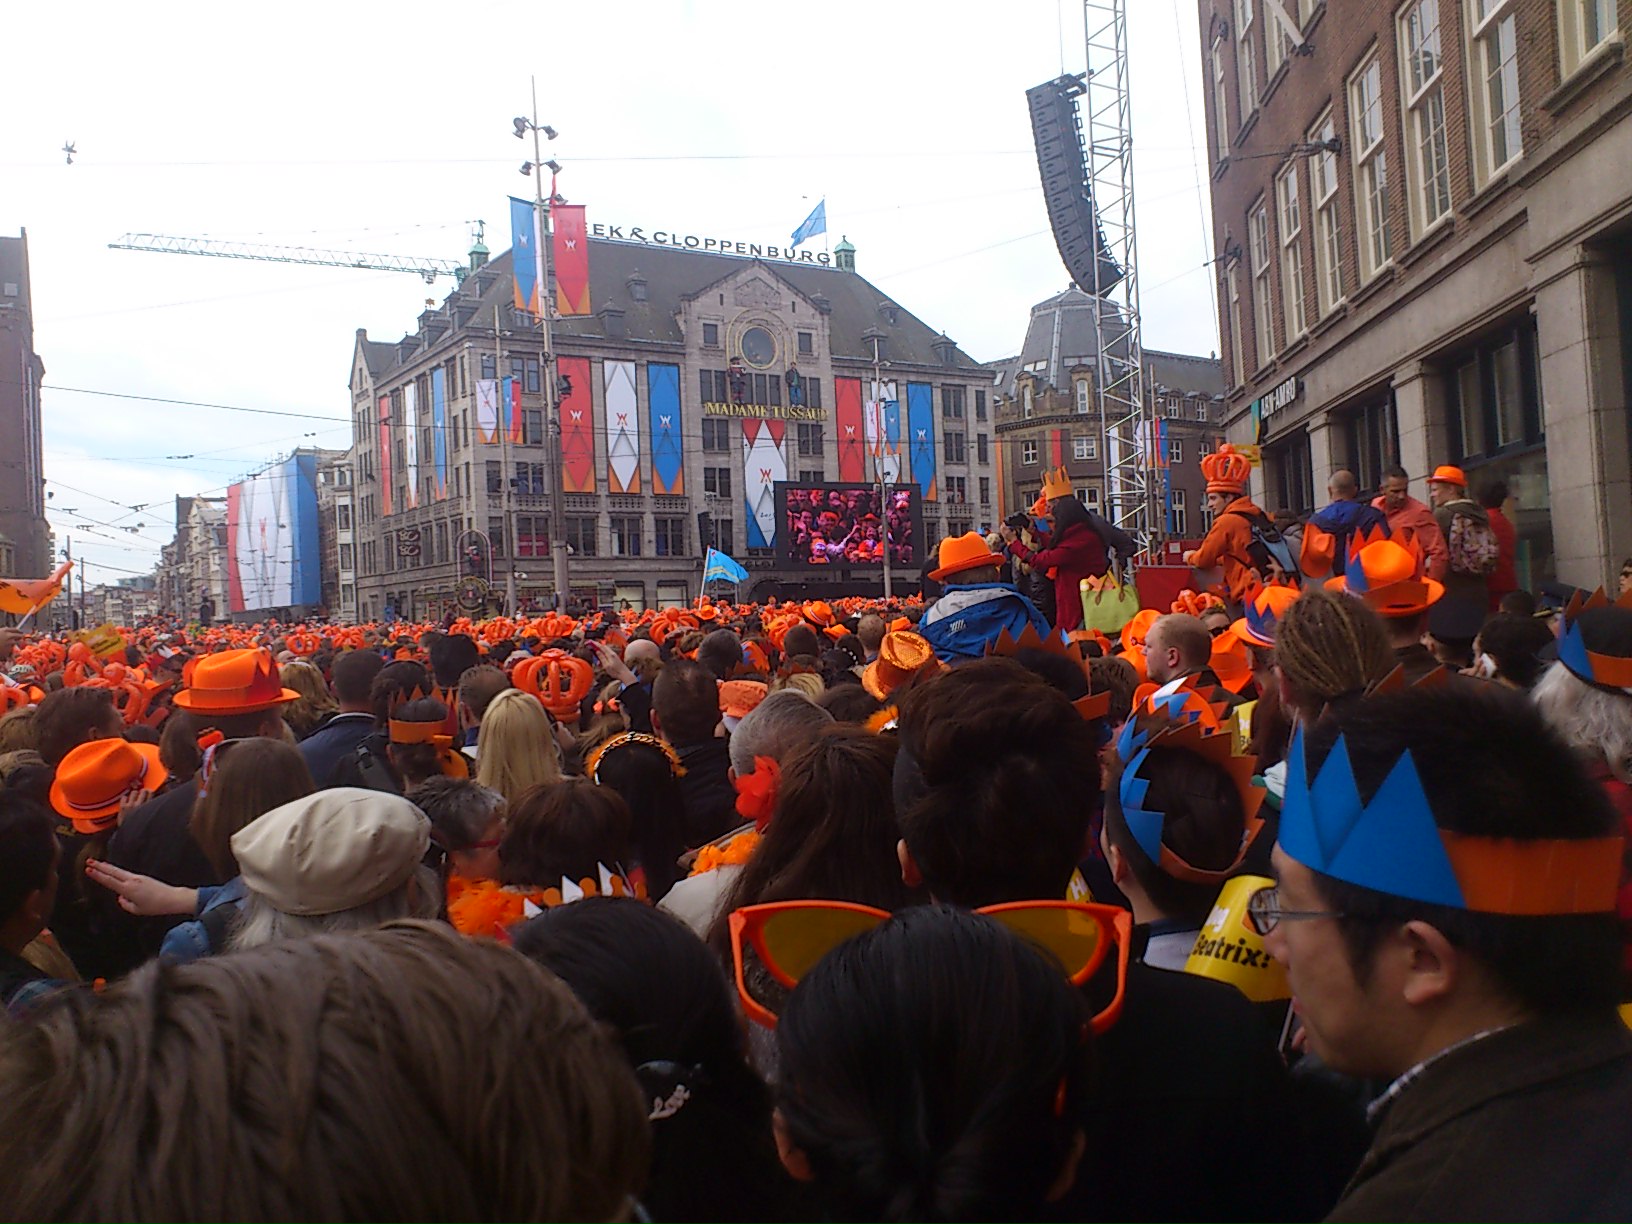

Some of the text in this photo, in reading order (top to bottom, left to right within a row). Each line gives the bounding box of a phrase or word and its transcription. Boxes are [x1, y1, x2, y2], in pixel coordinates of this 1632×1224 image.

[586, 222, 831, 264] EK & CLOPPENBURG
[704, 402, 768, 418] MADAME
